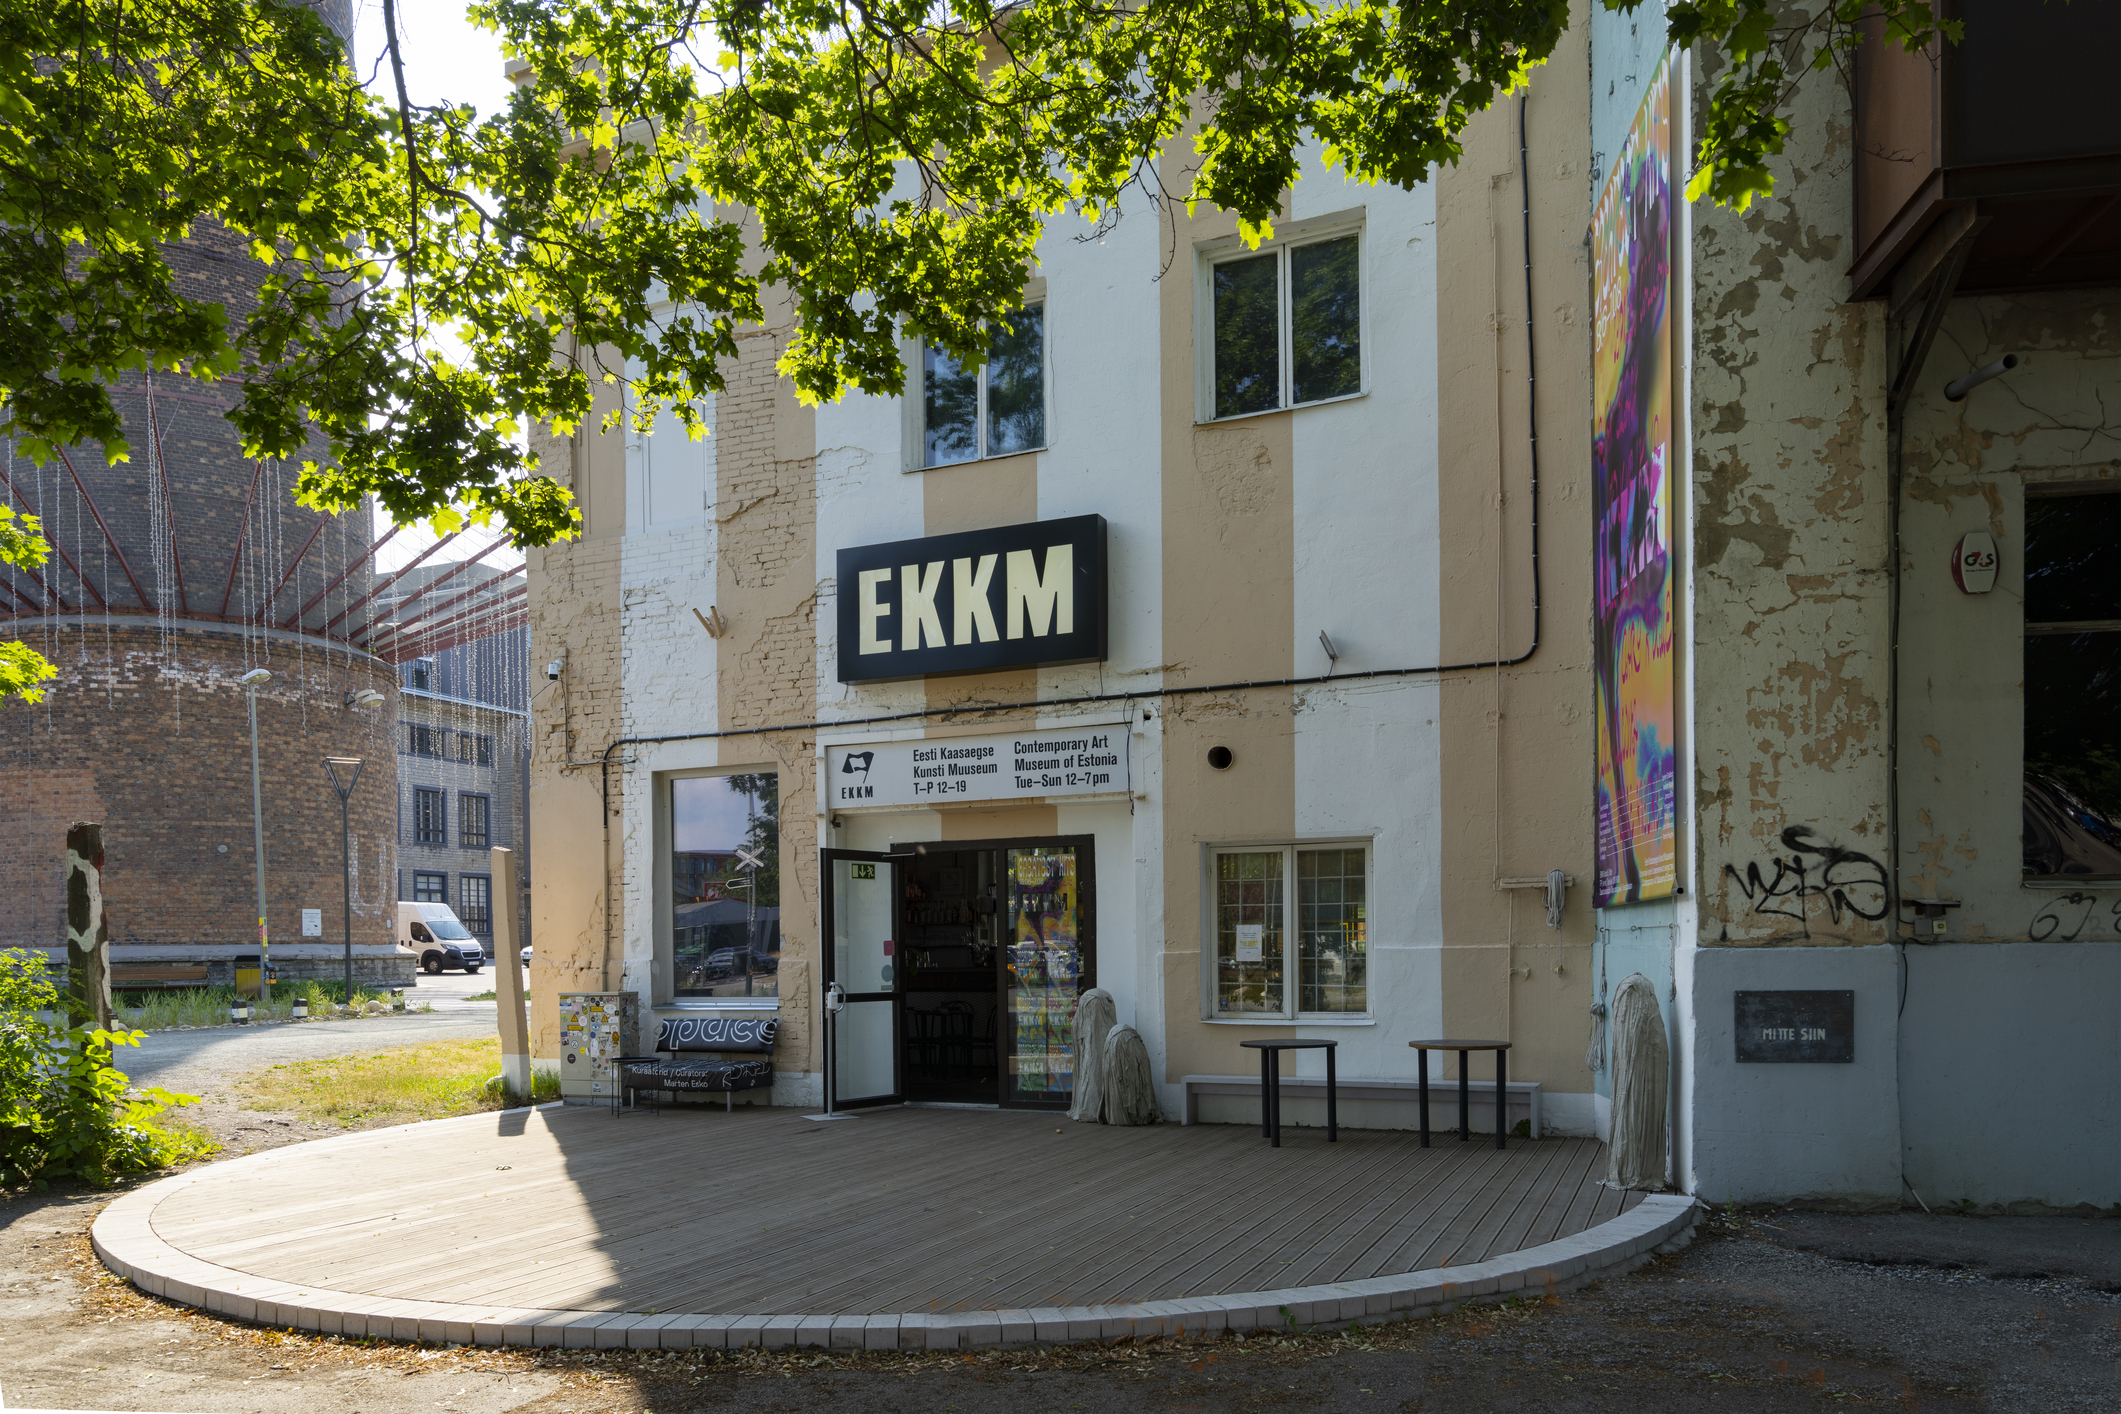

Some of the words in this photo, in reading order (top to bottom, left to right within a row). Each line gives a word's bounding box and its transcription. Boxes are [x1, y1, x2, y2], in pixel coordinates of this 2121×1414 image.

[1964, 552, 1994, 568] G4S
[858, 543, 1074, 656] EKKM
[1014, 738, 1088, 755] Contemporary
[1092, 735, 1108, 749] Art
[913, 748, 937, 762] Eesti
[941, 746, 994, 760] Kaasaegse
[1015, 756, 1060, 772] Museum
[1063, 755, 1075, 769] of
[1078, 752, 1118, 768] Estonia
[913, 763, 944, 778] Kunsti
[948, 762, 998, 776] Muuseum
[841, 785, 873, 799] EKKM
[1058, 855, 1075, 877] HITS
[1762, 1028, 1795, 1041] MITTE
[1800, 1028, 1826, 1041] SIIN
[663, 1079, 690, 1087] Marten
[691, 1080, 709, 1088] Esko
